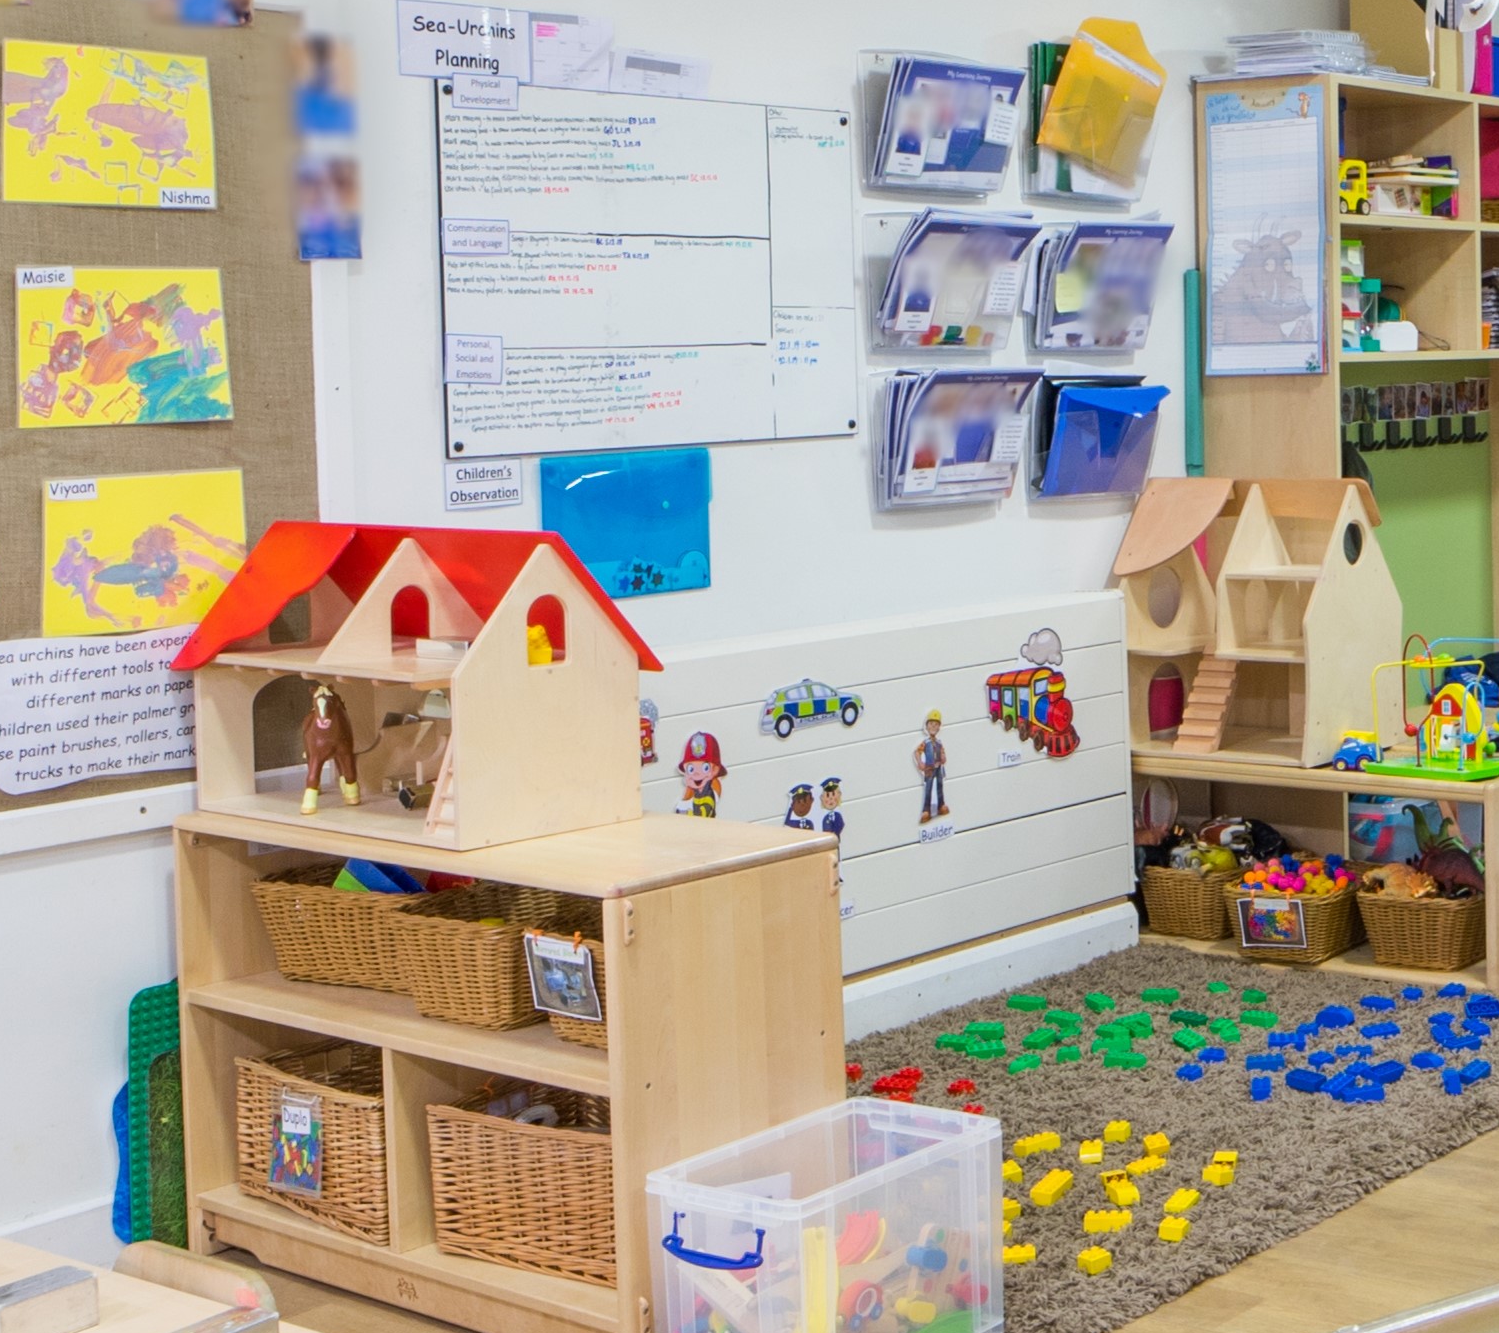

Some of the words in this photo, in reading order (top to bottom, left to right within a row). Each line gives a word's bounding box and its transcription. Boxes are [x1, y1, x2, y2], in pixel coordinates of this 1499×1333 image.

[413, 16, 516, 40] Sea-Urchins
[435, 49, 500, 75] Planning
[471, 79, 501, 89] Physical
[460, 94, 511, 106] Development
[162, 190, 211, 205] Nishma
[447, 224, 506, 234] Communication
[452, 239, 469, 248] and
[471, 239, 503, 250] Language
[22, 271, 66, 284] Maisie
[457, 339, 492, 350] Personal,
[455, 354, 477, 363] Social
[480, 354, 494, 363] and
[456, 370, 492, 380] Emotions
[456, 466, 512, 481] Children's
[50, 482, 95, 499] Viyaan
[450, 486, 519, 503] Observation
[19, 647, 74, 663] urchins
[79, 642, 111, 657] have
[115, 640, 147, 654] been
[151, 631, 192, 651] experi
[11, 673, 44, 687] with
[50, 665, 118, 684] different
[123, 660, 153, 675] tools
[158, 659, 171, 671] to
[27, 690, 96, 709] different
[101, 685, 141, 701] marks
[146, 683, 160, 695] on
[164, 680, 193, 698] pape
[56, 717, 90, 732] used
[95, 711, 129, 727] their
[133, 707, 176, 725] palmer
[180, 703, 195, 719] gr
[19, 744, 56, 764] paint
[62, 736, 122, 755] brushes,
[126, 728, 173, 745] rollers,
[177, 726, 195, 737] car
[15, 765, 63, 783] trucks
[69, 763, 83, 776] to
[87, 758, 122, 773] make
[127, 753, 160, 767] their
[164, 745, 196, 761] mark
[1001, 752, 1021, 763] Train
[921, 825, 953, 842] Builder
[284, 1107, 308, 1126] Duplo
